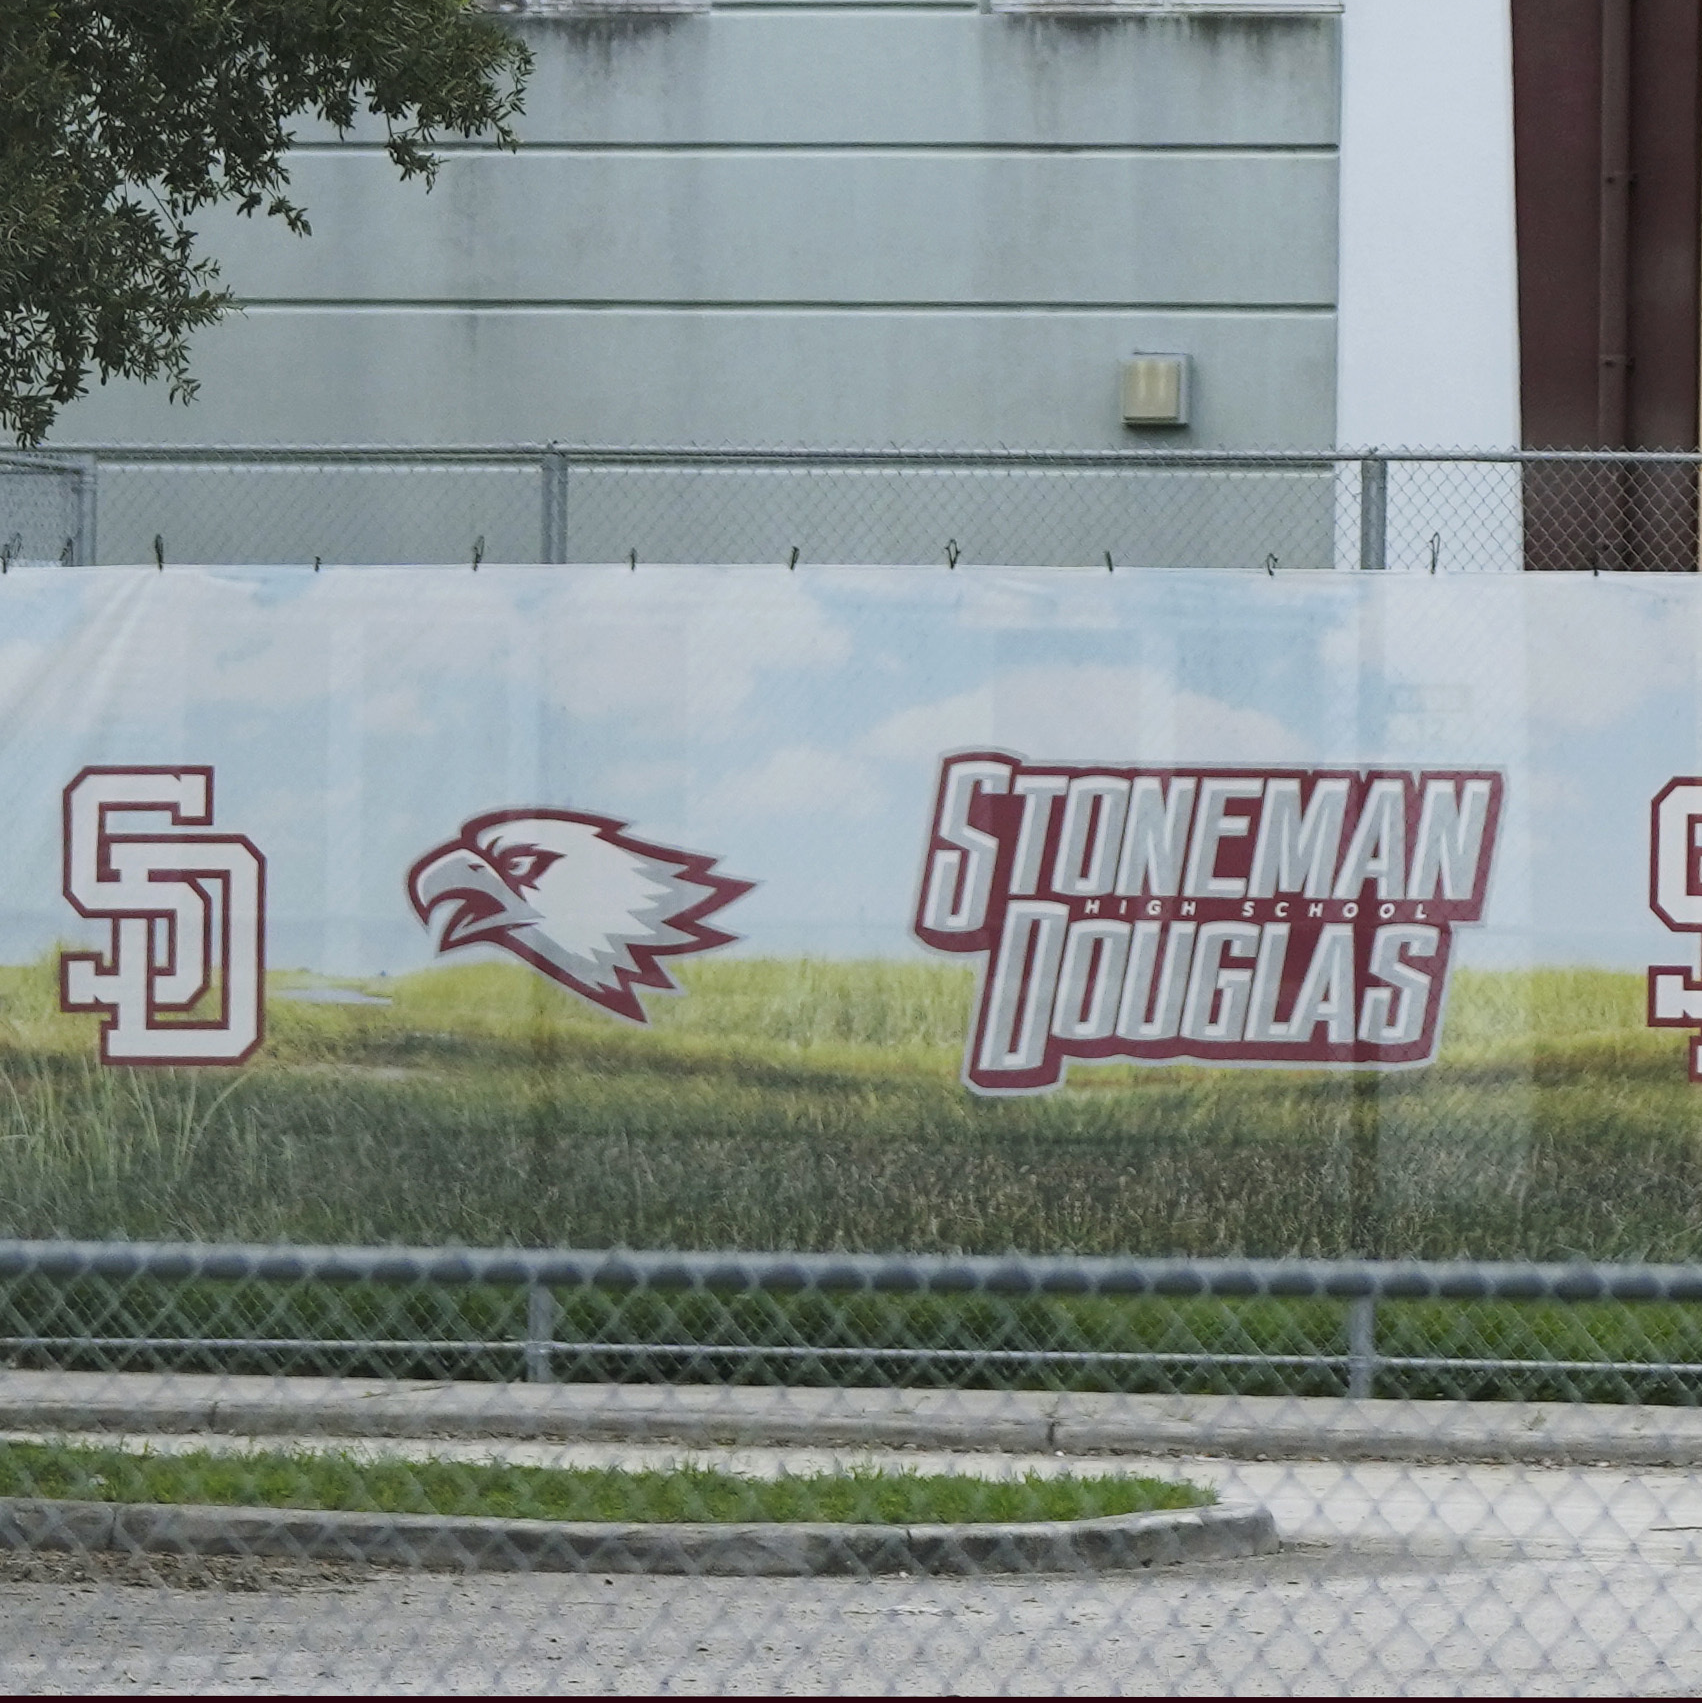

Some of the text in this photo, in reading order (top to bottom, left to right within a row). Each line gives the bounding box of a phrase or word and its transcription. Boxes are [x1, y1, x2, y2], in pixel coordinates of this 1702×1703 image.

[60, 765, 267, 1066] SD
[920, 758, 1493, 933] STONEMAN
[1083, 898, 1429, 919] HIGH SCHOOL
[977, 899, 1440, 1072] DOUGLAS
